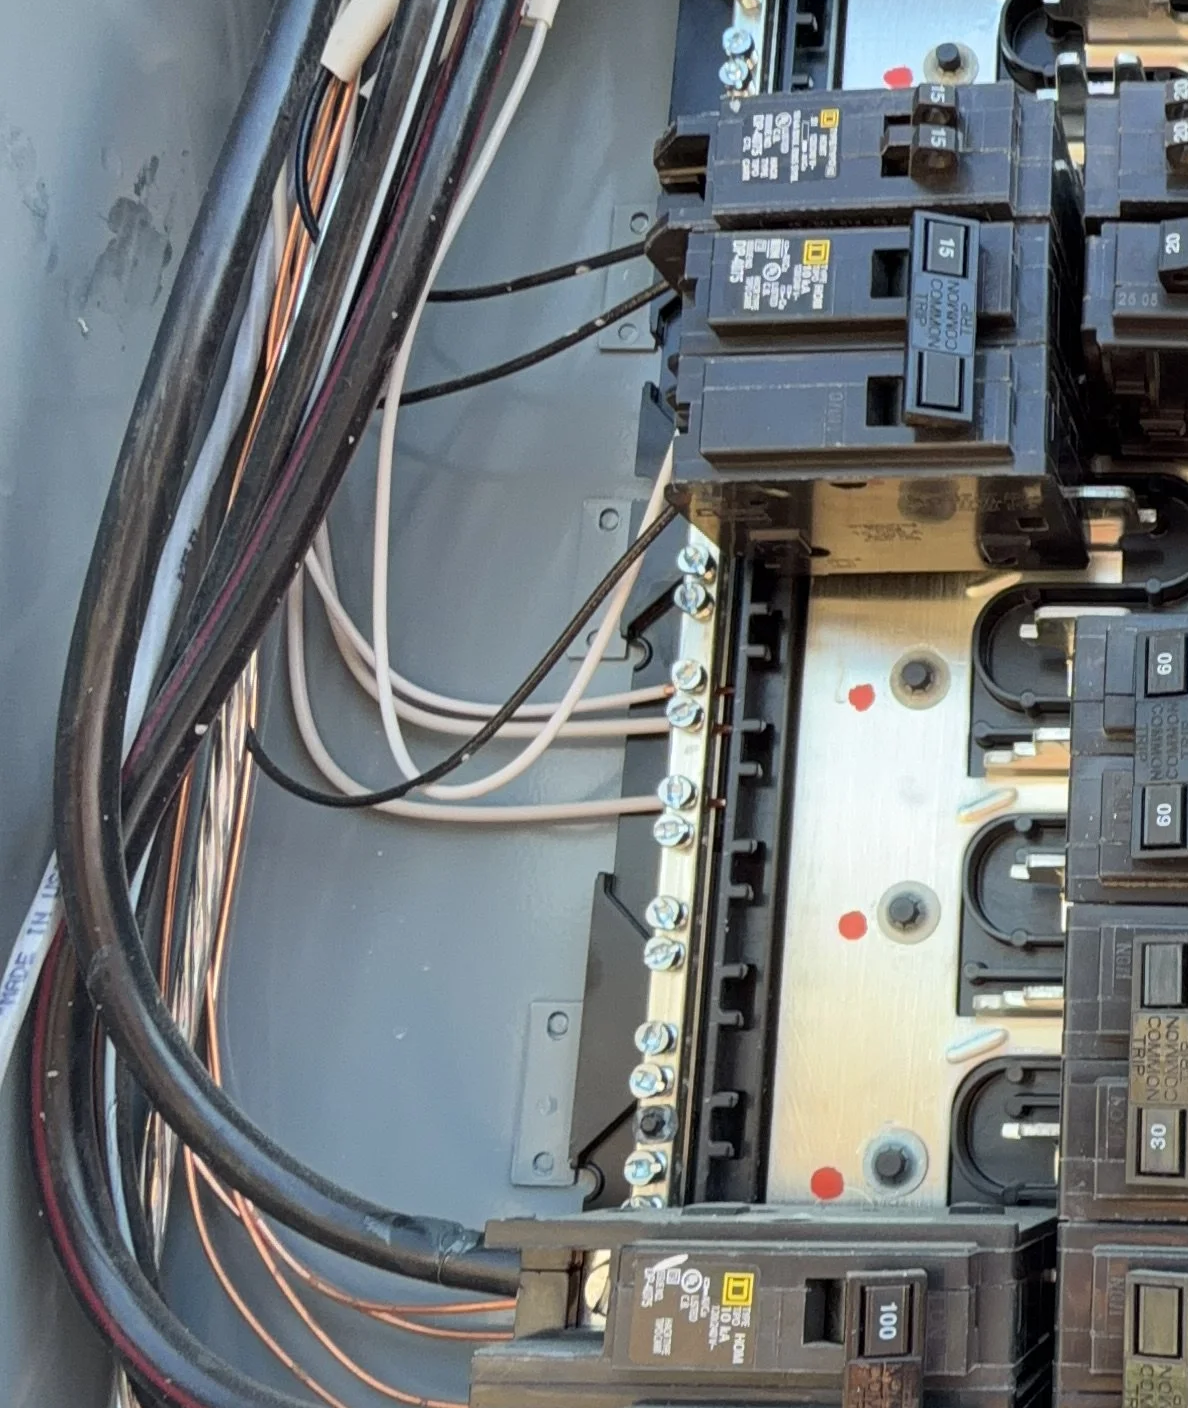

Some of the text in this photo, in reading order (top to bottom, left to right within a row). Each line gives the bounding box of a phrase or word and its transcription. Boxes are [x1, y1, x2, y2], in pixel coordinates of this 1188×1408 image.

[930, 85, 946, 103] 15
[1173, 78, 1188, 101] 20
[930, 128, 947, 147] 15
[1173, 121, 1188, 143] 20
[939, 238, 955, 259] 15
[1165, 233, 1180, 255] 20
[915, 293, 928, 326] TRIP
[928, 278, 943, 349] COMMON
[945, 282, 959, 351] COMMON
[960, 302, 972, 337] TRIP
[1157, 652, 1173, 675] 60
[1137, 724, 1148, 761] TRIP
[1150, 703, 1163, 781] COMMON
[1166, 701, 1179, 780] COMMON
[1156, 803, 1172, 827] 60
[26, 913, 52, 934] IN
[1132, 1037, 1146, 1077] TRIP
[1146, 1016, 1162, 1102] COMMON
[1164, 1015, 1180, 1102] COMMON
[1150, 1123, 1166, 1150] 30
[721, 1306, 730, 1322] 10
[878, 1302, 898, 1340] 100
[733, 1333, 745, 1364] HOM
